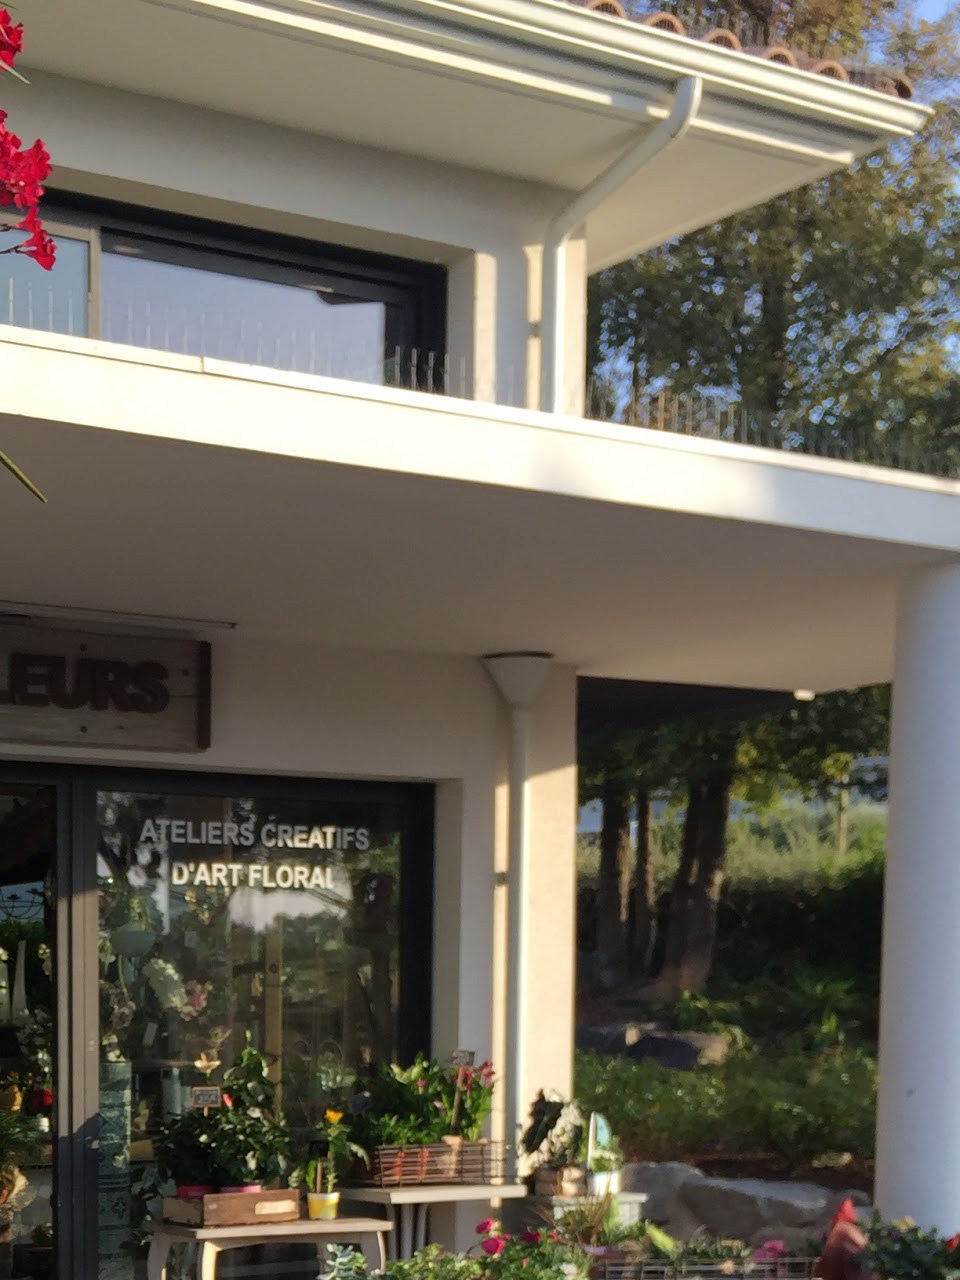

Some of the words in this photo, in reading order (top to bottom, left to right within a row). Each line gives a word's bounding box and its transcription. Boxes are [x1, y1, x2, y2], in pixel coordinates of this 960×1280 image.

[140, 819, 255, 847] ATELIERS
[260, 824, 370, 851] CREATIFS
[171, 862, 242, 888] D'ART
[248, 864, 334, 889] FLORAL
